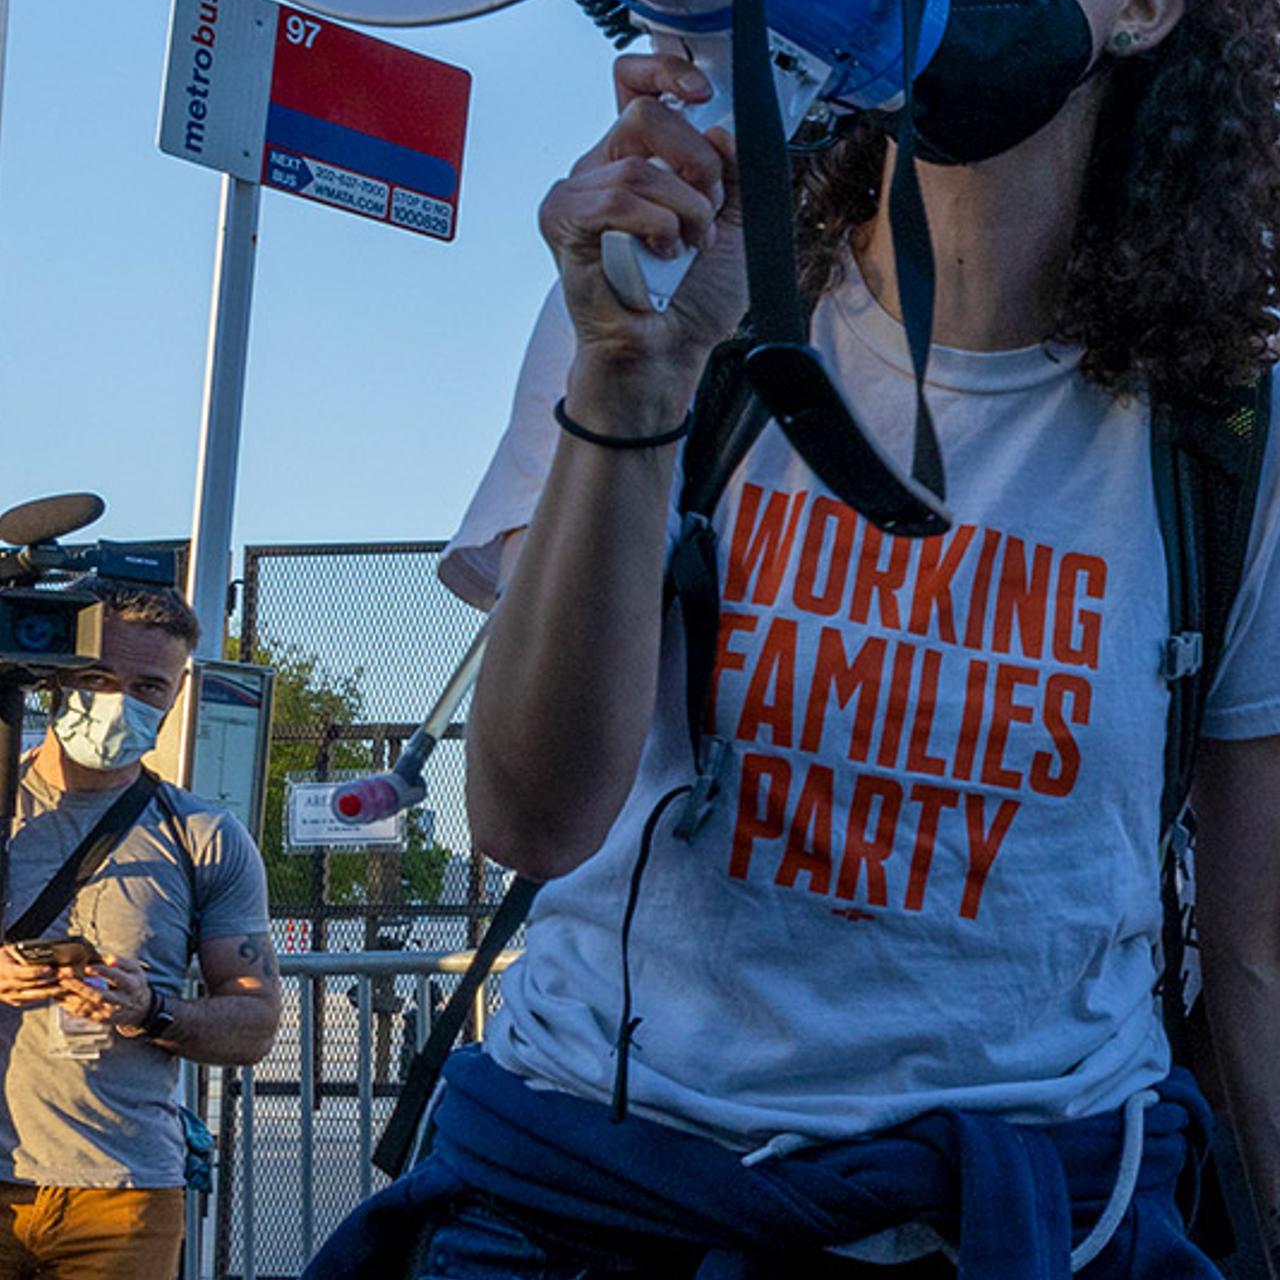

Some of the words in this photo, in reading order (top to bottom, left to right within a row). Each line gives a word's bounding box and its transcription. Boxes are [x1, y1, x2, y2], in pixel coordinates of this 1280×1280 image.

[286, 15, 321, 49] 97
[723, 482, 1108, 671] WORKING
[706, 612, 1093, 798] FAMILIES
[729, 752, 1021, 920] PARTY
